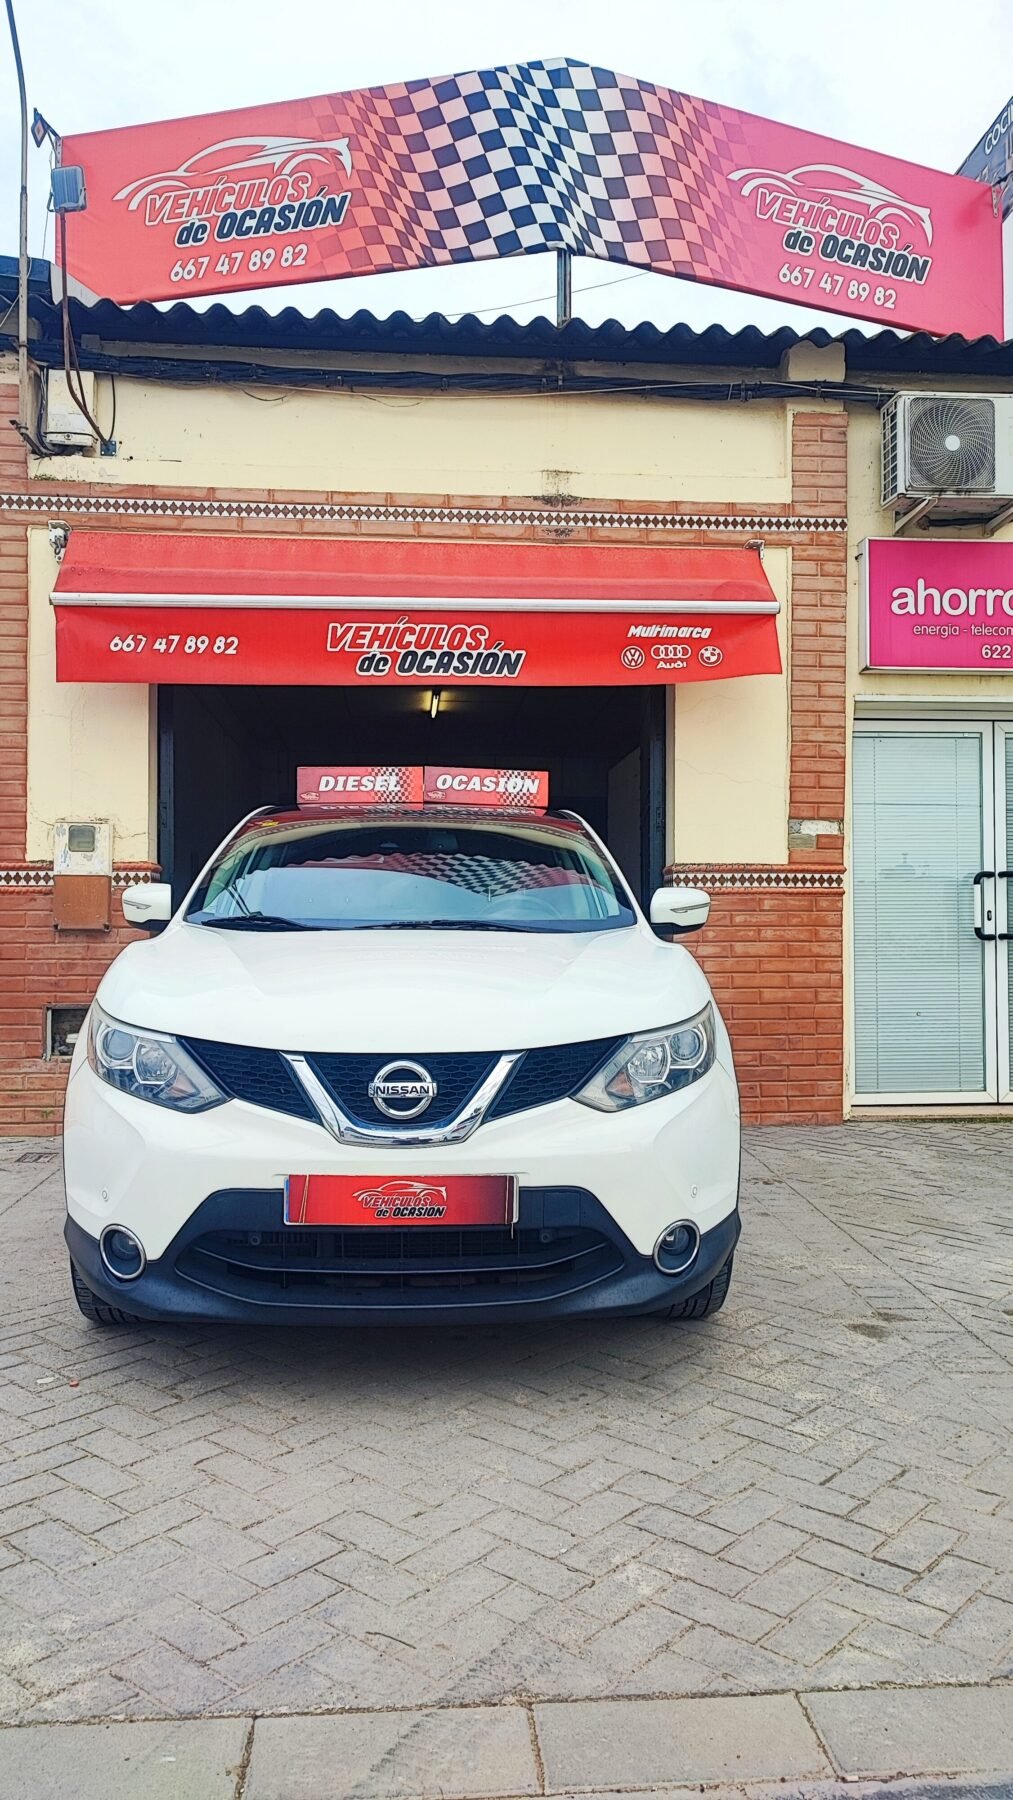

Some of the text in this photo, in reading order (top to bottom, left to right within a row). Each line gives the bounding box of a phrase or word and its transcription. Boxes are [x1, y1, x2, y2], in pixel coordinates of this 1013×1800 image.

[984, 103, 1013, 155] COCI
[145, 173, 312, 226] VEHÍCULOS
[175, 187, 351, 248] de OCASIÓN
[755, 187, 900, 251] VEHÍCULOS
[170, 243, 308, 282] 667 47 89 82
[782, 227, 933, 285] de OCASIÓN
[778, 263, 897, 309] 667 47 89 82
[109, 635, 239, 654] 667 47 89 82
[326, 616, 490, 652] VEHÍCULOS
[627, 624, 712, 639] Multimarca
[356, 641, 527, 678] de OCASIÓN
[656, 660, 687, 669] Audi
[981, 644, 1012, 659] 622
[319, 775, 401, 792] DIESEL
[375, 1085, 430, 1096] NISSAN
[375, 1207, 390, 1218] de
